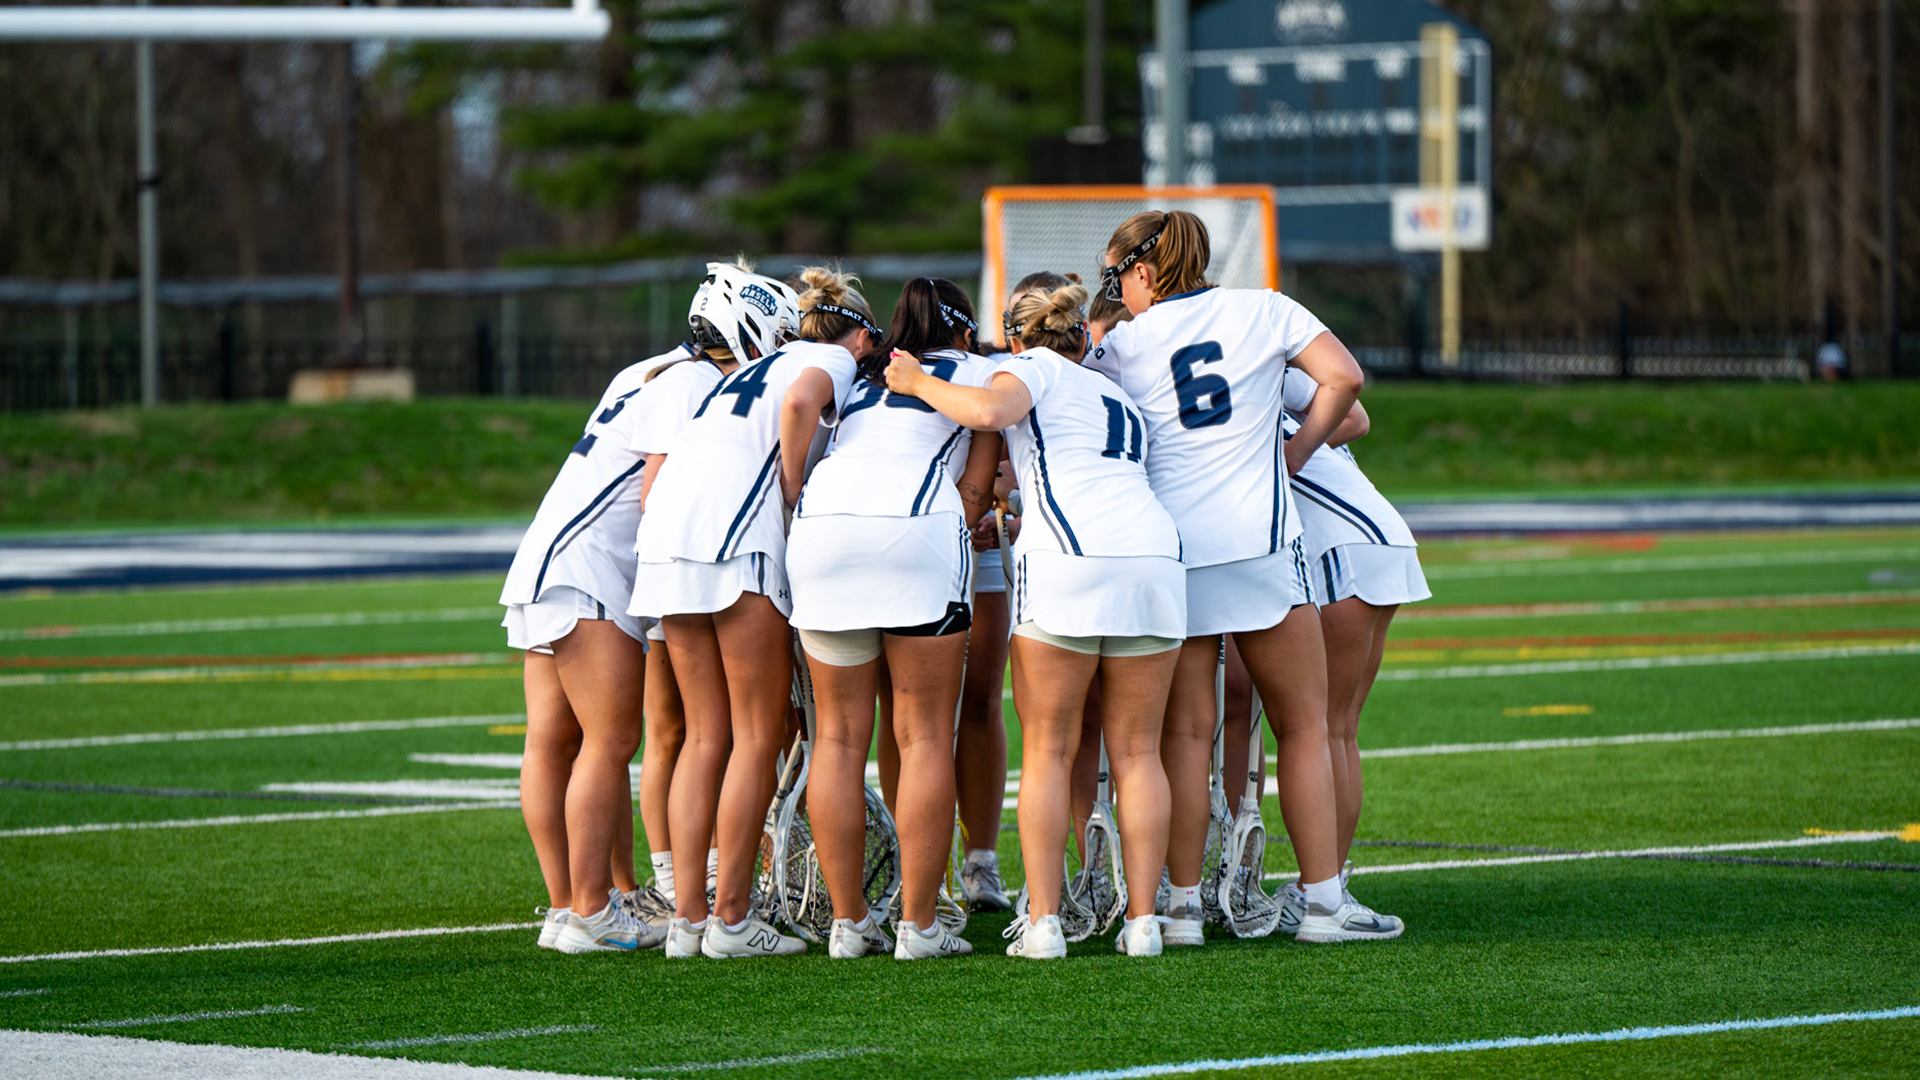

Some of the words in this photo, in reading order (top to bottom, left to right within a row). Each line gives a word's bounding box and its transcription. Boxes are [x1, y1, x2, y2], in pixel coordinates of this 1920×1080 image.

[1117, 252, 1138, 273] STX
[700, 297, 709, 311] 2
[740, 287, 777, 315] ANSELM
[841, 308, 862, 322] GAIT
[692, 351, 787, 420] 14
[1170, 340, 1233, 430] 6
[1100, 394, 1143, 464] 11
